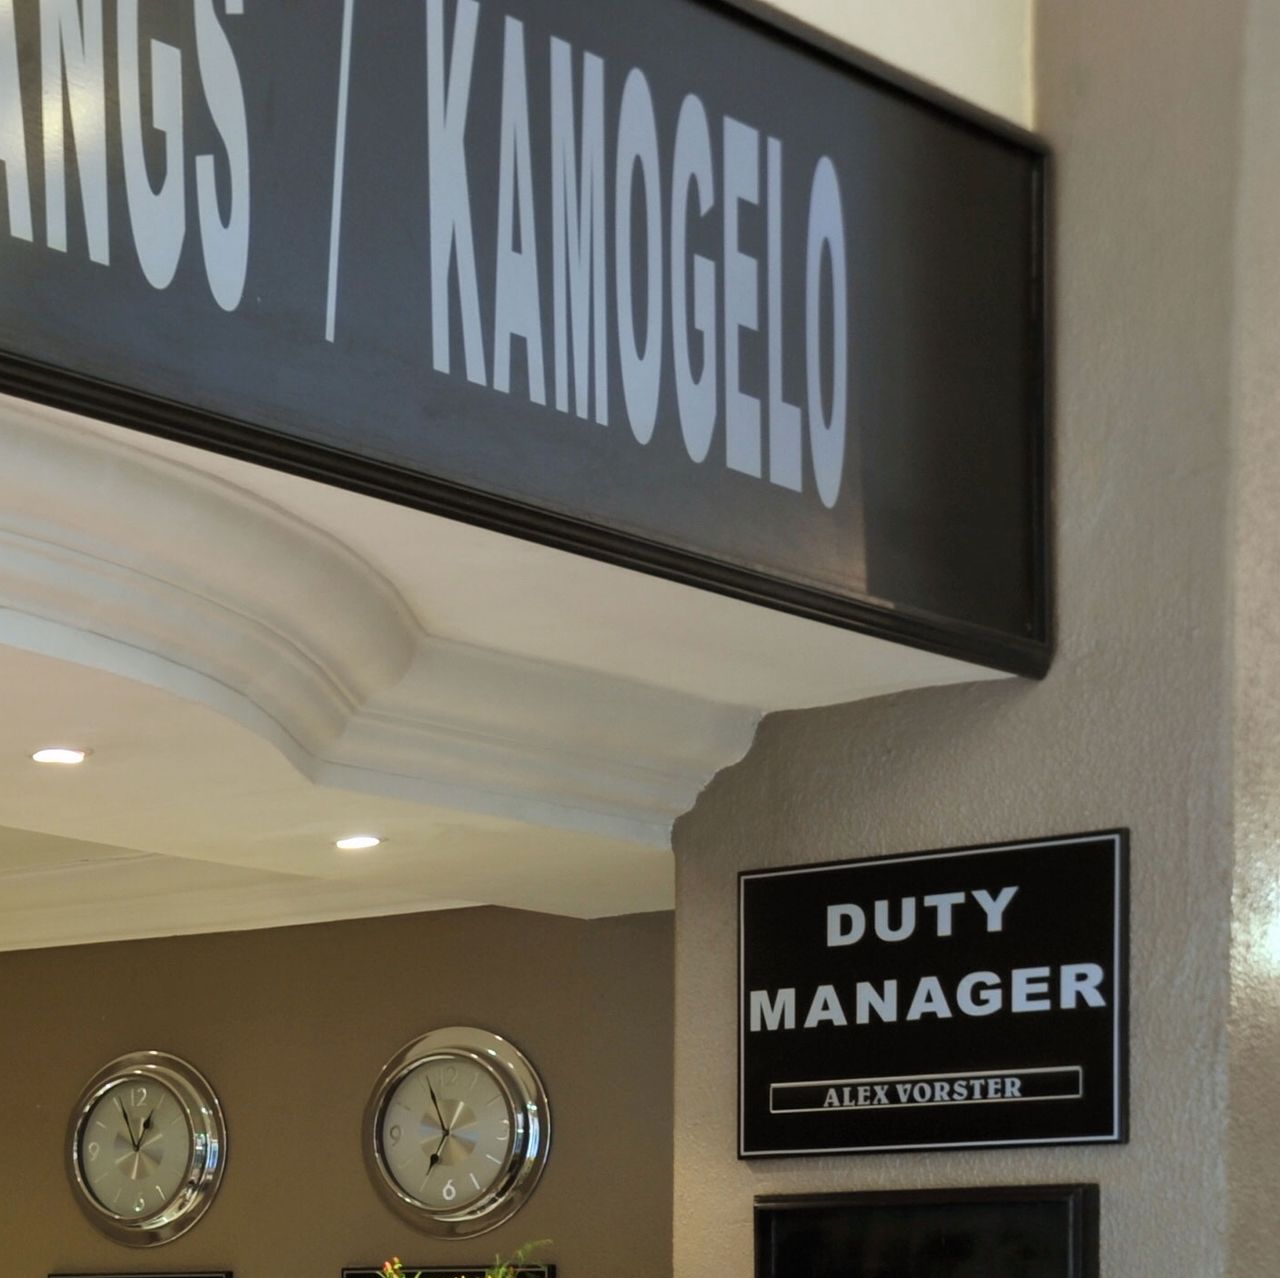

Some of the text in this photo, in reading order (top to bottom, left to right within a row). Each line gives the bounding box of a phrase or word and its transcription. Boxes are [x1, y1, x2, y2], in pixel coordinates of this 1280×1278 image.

[426, 0, 847, 509] KAMOGELO
[826, 886, 1020, 947] DUTY
[749, 962, 1107, 1032] MANAGER
[130, 1087, 148, 1107] 12
[824, 1077, 1022, 1108] ALEX VORSTER
[88, 1142, 101, 1161] 9
[442, 1178, 457, 1201] 6
